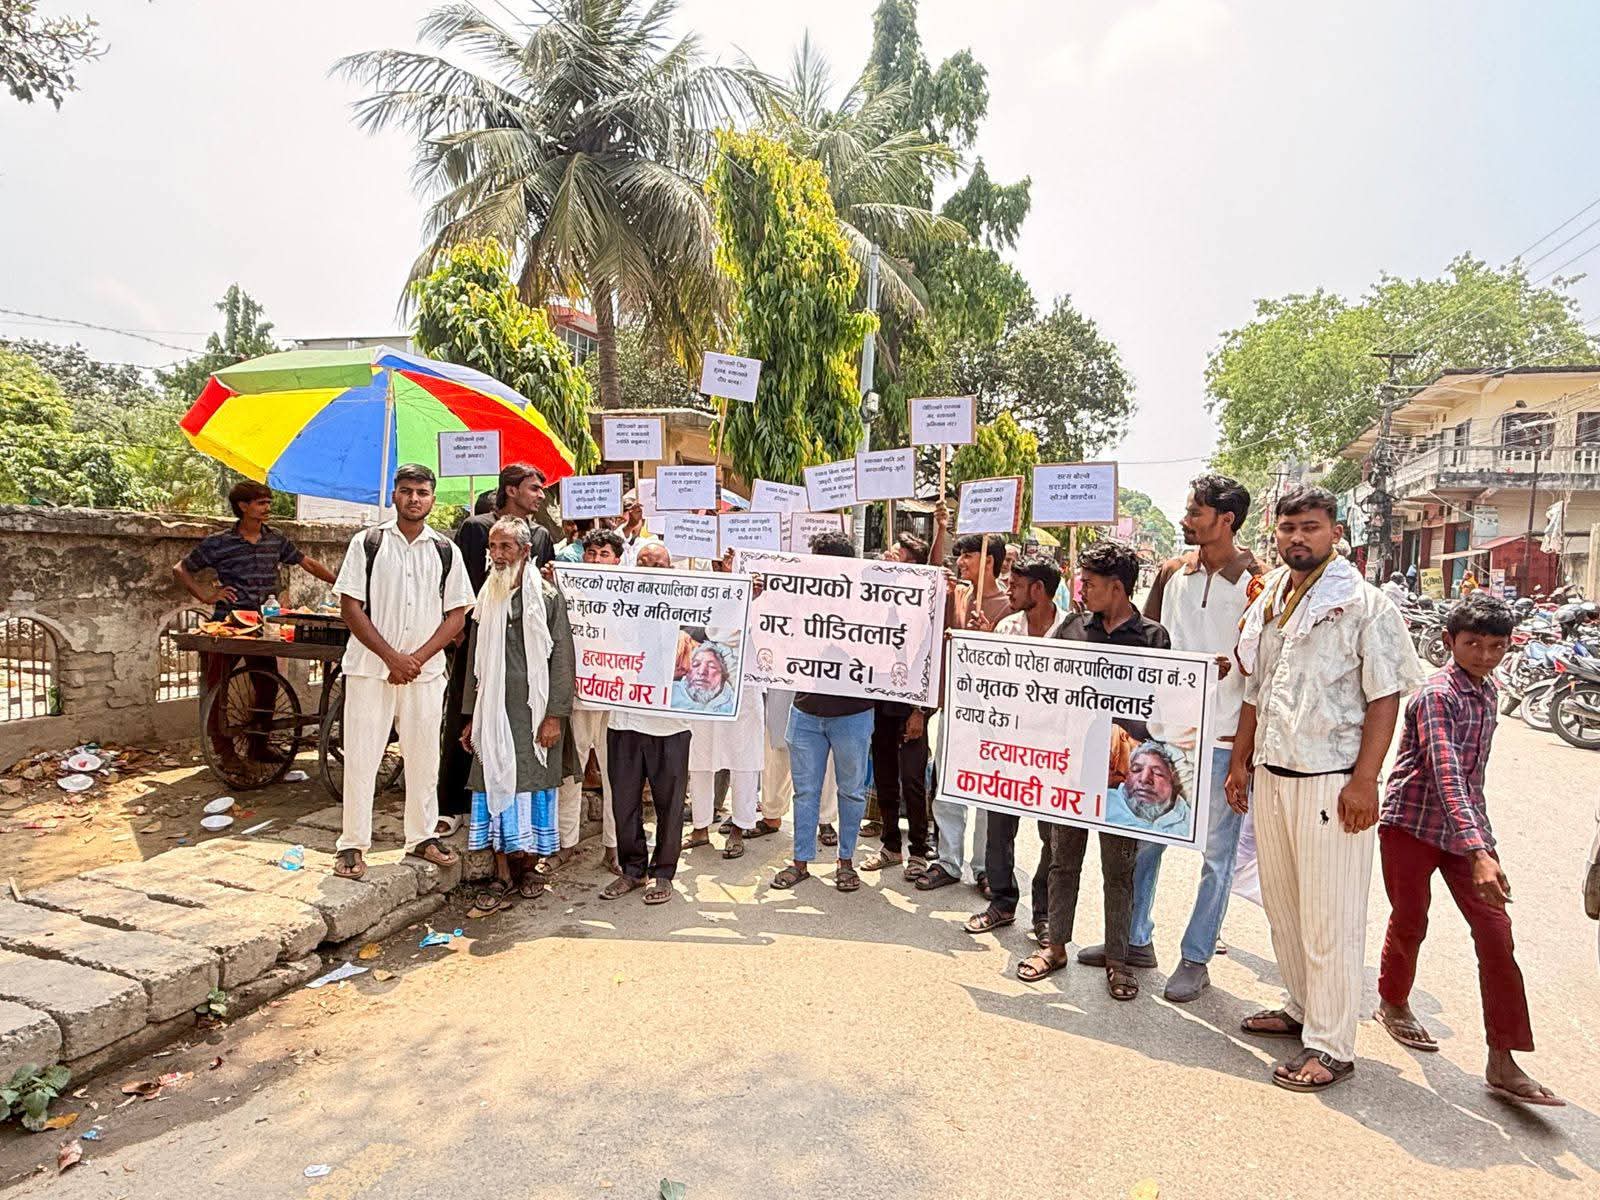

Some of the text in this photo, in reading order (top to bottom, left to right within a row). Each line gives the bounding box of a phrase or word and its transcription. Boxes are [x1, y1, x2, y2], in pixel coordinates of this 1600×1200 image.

[607, 578, 634, 594] परोहा
[637, 581, 699, 598] नगरपालिका
[701, 586, 719, 600] वडा
[860, 582, 925, 607] अन्त्य
[576, 600, 607, 617] मृतक
[612, 599, 640, 618] शेख
[644, 602, 712, 626] मतिनलाई
[805, 613, 907, 650] पीडितलाई
[582, 649, 645, 674] हत्यारालाई
[786, 657, 842, 681] न्याय
[956, 642, 1011, 667] रौतहटको
[1014, 650, 1050, 674] परोहा
[1054, 657, 1134, 682] नगरपालिका
[1138, 665, 1163, 685] वडा
[629, 683, 656, 705] गर
[956, 673, 1155, 718] को मृतक शेख मतिनलाई
[955, 706, 985, 724] न्याय
[988, 706, 1011, 728] देऊ
[979, 739, 1071, 775] हत्यारालाई
[956, 769, 1044, 806] कार्यवाही
[1051, 785, 1085, 815] गर
